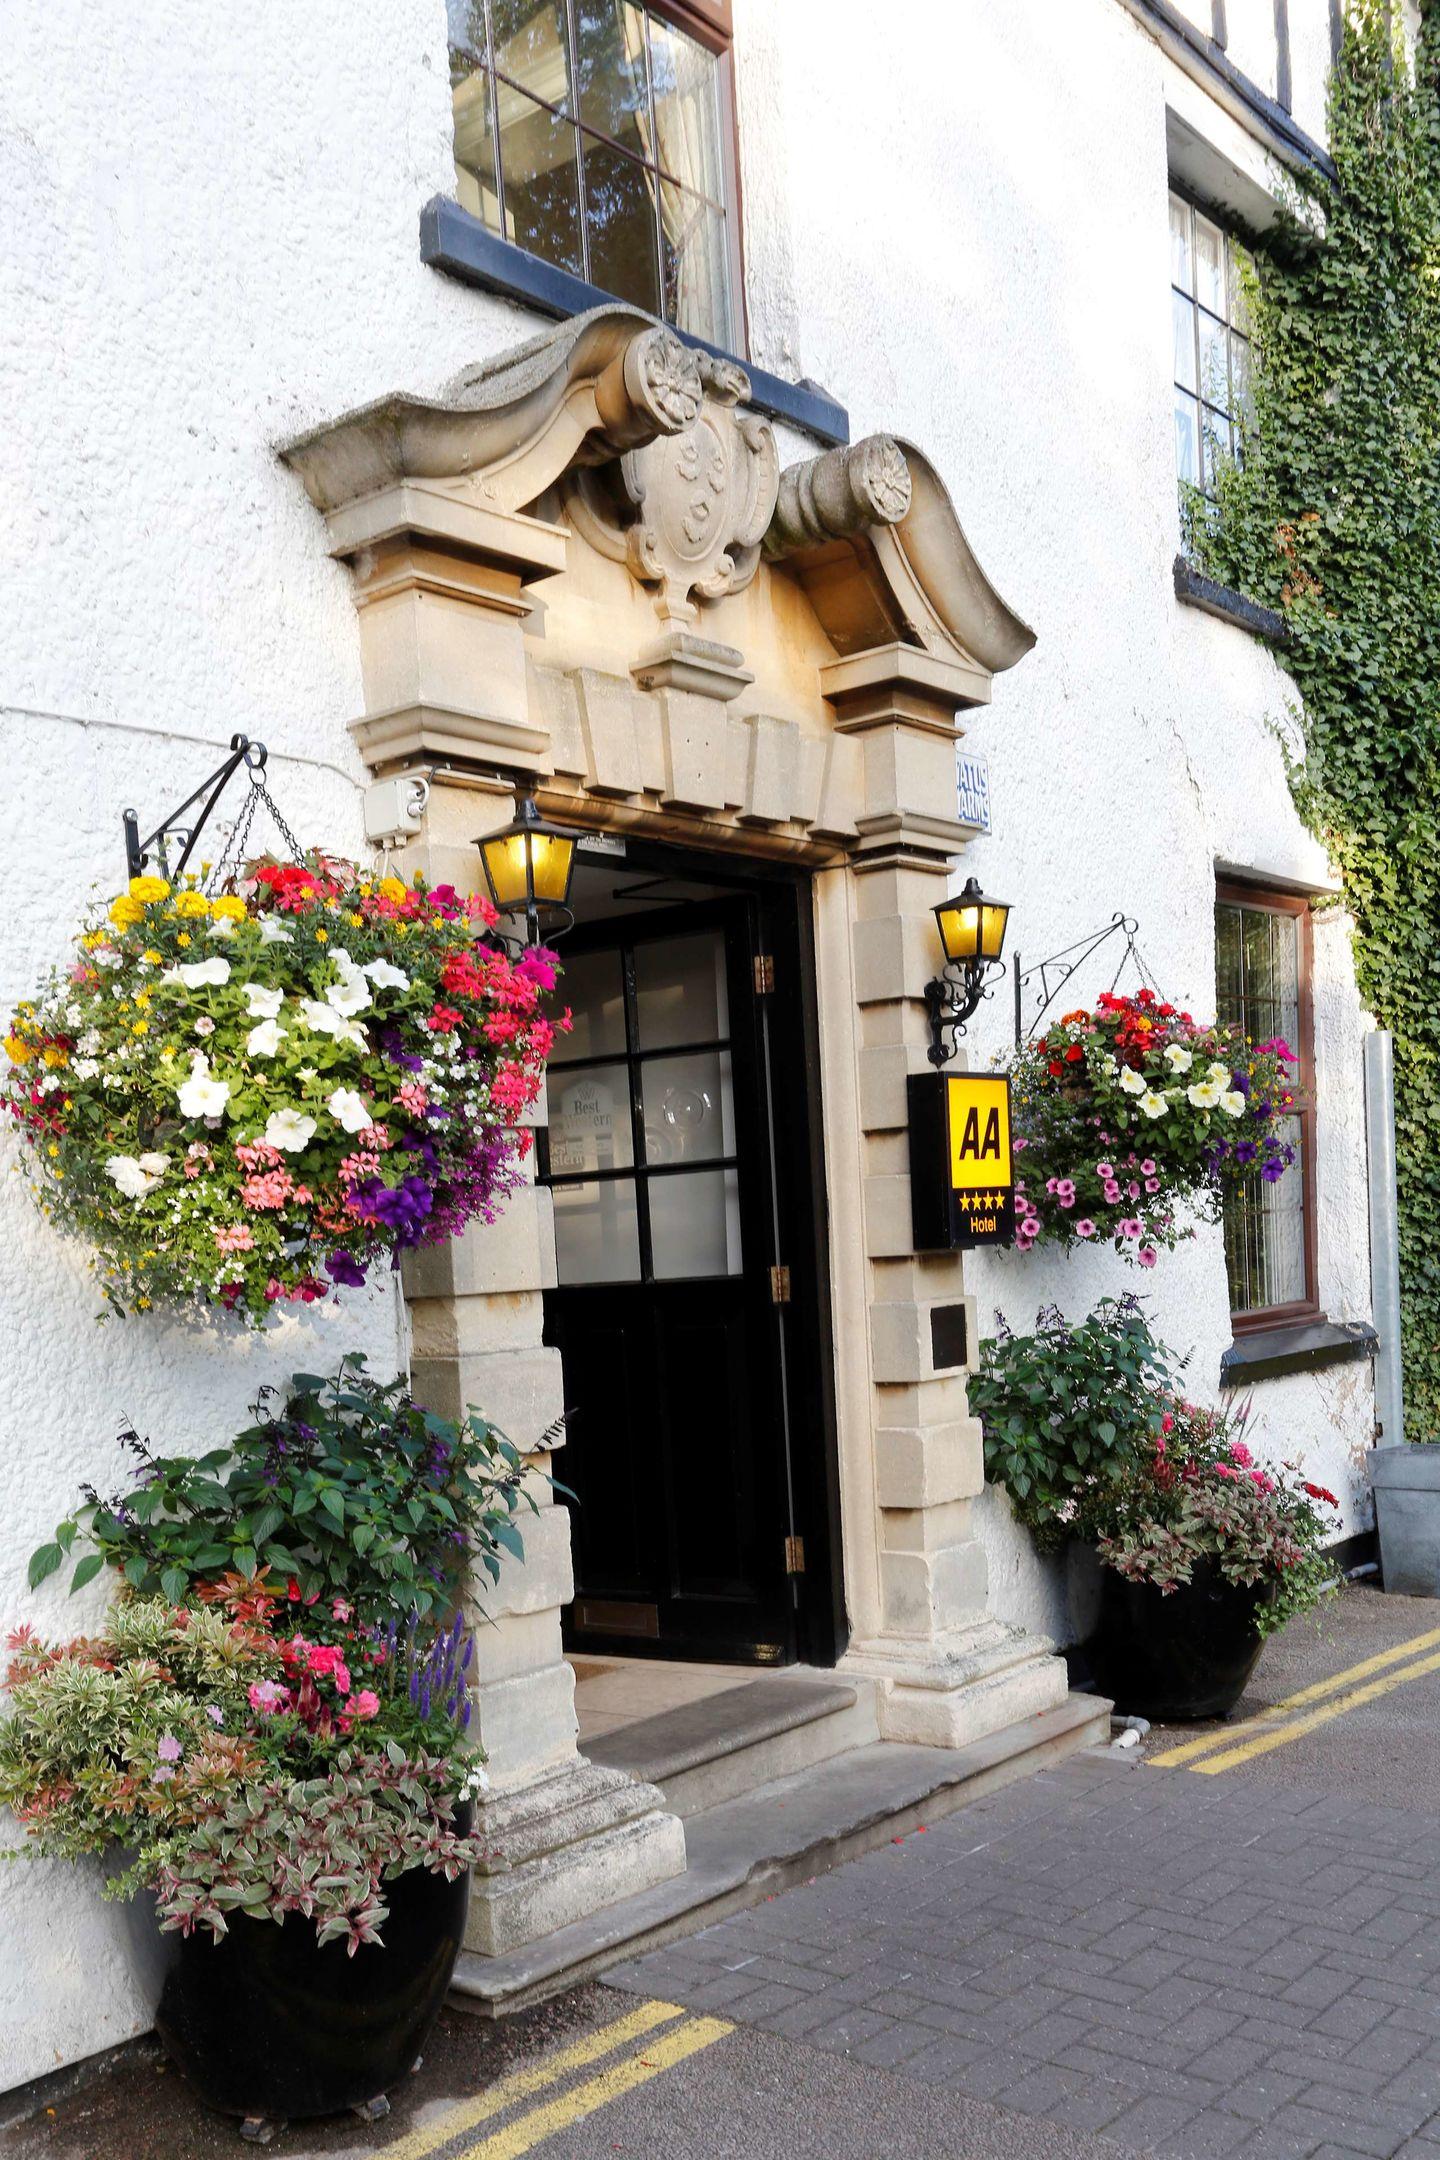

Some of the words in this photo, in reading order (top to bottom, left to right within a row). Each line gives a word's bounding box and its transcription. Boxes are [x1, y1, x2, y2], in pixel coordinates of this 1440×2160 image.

[957, 760, 988, 797] AIUS
[958, 792, 989, 827] ARMS
[574, 1099, 599, 1115] Best
[959, 1107, 1000, 1160] AA
[970, 1216, 997, 1233] Hotel
